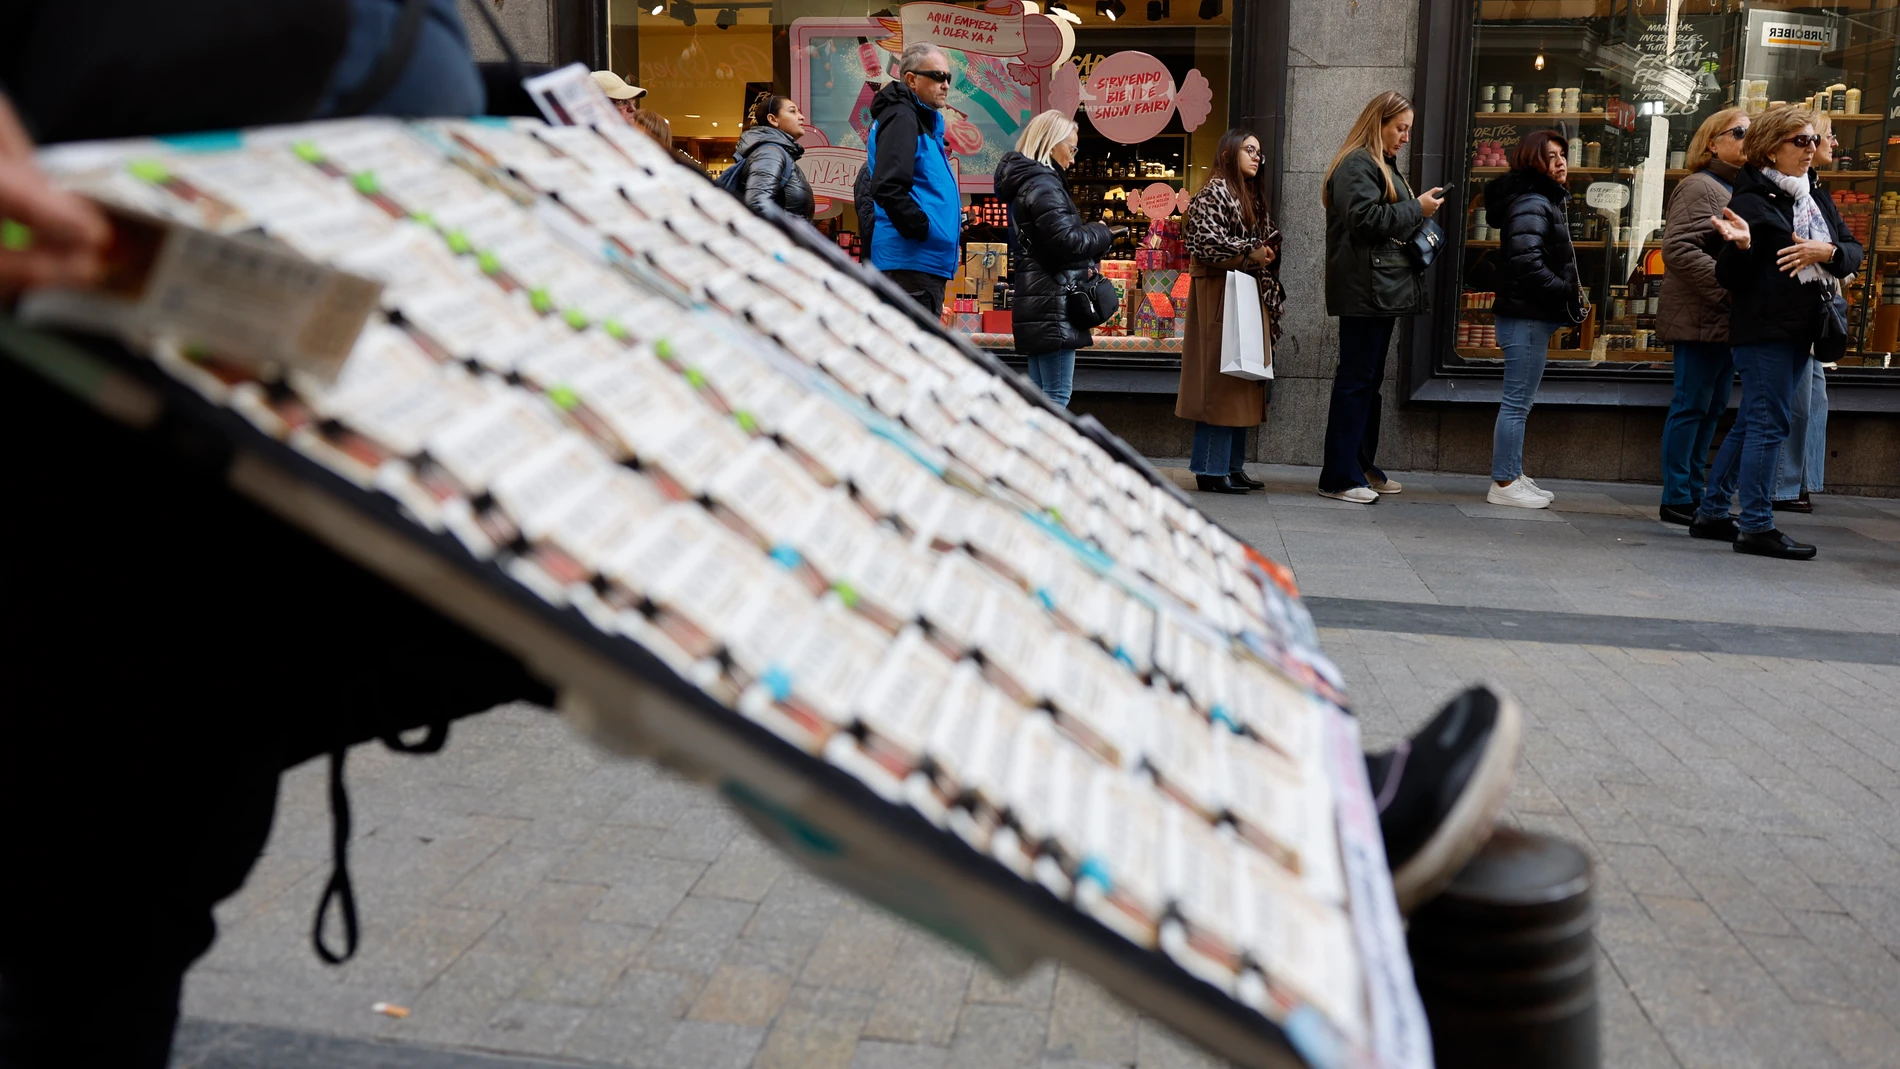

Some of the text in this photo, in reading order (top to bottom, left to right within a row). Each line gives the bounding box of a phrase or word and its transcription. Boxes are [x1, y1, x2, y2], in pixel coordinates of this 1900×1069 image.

[927, 11, 998, 32] AQUÍ EMPIEZA
[932, 25, 994, 44] A OLER YA A
[1698, 41, 1709, 50] Y
[1097, 71, 1161, 89] SIRVIENDO
[1107, 87, 1137, 104] BIEN
[1139, 86, 1156, 100] DE
[1095, 99, 1170, 120] SNOW FAIRY
[1473, 124, 1516, 137] ORITOS
